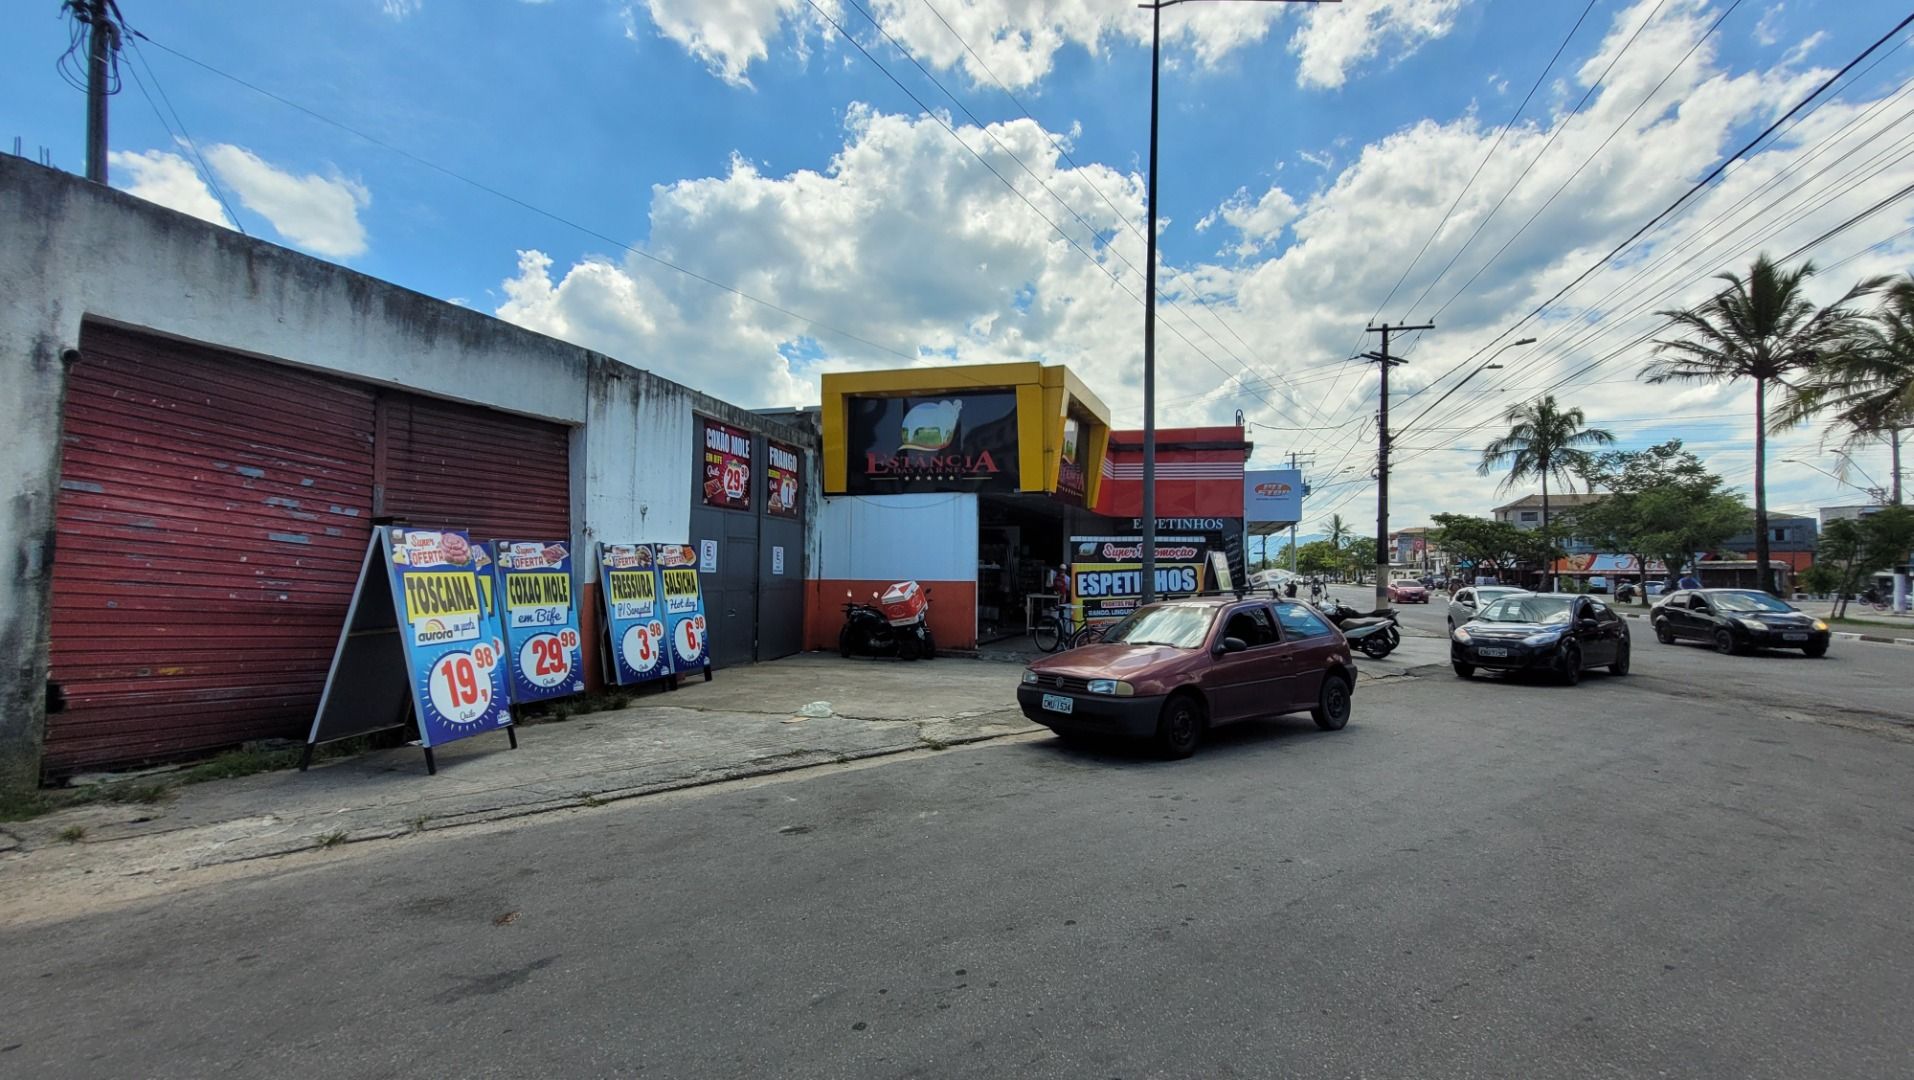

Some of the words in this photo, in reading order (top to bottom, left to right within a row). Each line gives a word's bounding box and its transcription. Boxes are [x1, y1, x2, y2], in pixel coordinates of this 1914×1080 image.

[706, 425, 730, 453] COXÃO
[731, 435, 750, 459] MOLE
[769, 446, 798, 473] FRANGO
[1133, 518, 1224, 530] EPETINHOS
[411, 534, 433, 547] Super
[515, 545, 536, 557] Super
[1102, 543, 1137, 562] Super
[1137, 543, 1198, 560] Pomoção
[515, 556, 544, 568] OFERTA
[509, 575, 542, 605] COXAO
[543, 575, 568, 603] MOLE
[611, 573, 653, 599] FRESSURA
[664, 571, 697, 596] SALSICHA
[1077, 568, 1196, 595] ESPETIHOS
[406, 576, 477, 614] TOSCANA
[670, 598, 684, 609] Hot
[685, 597, 696, 611] dog
[518, 614, 535, 624] em
[535, 607, 562, 625] Bife
[695, 616, 705, 630] 98
[418, 630, 453, 642] aurora
[649, 623, 661, 637] 98
[560, 631, 576, 647] 98
[475, 647, 494, 668] 98
[460, 709, 476, 720] Quilo
